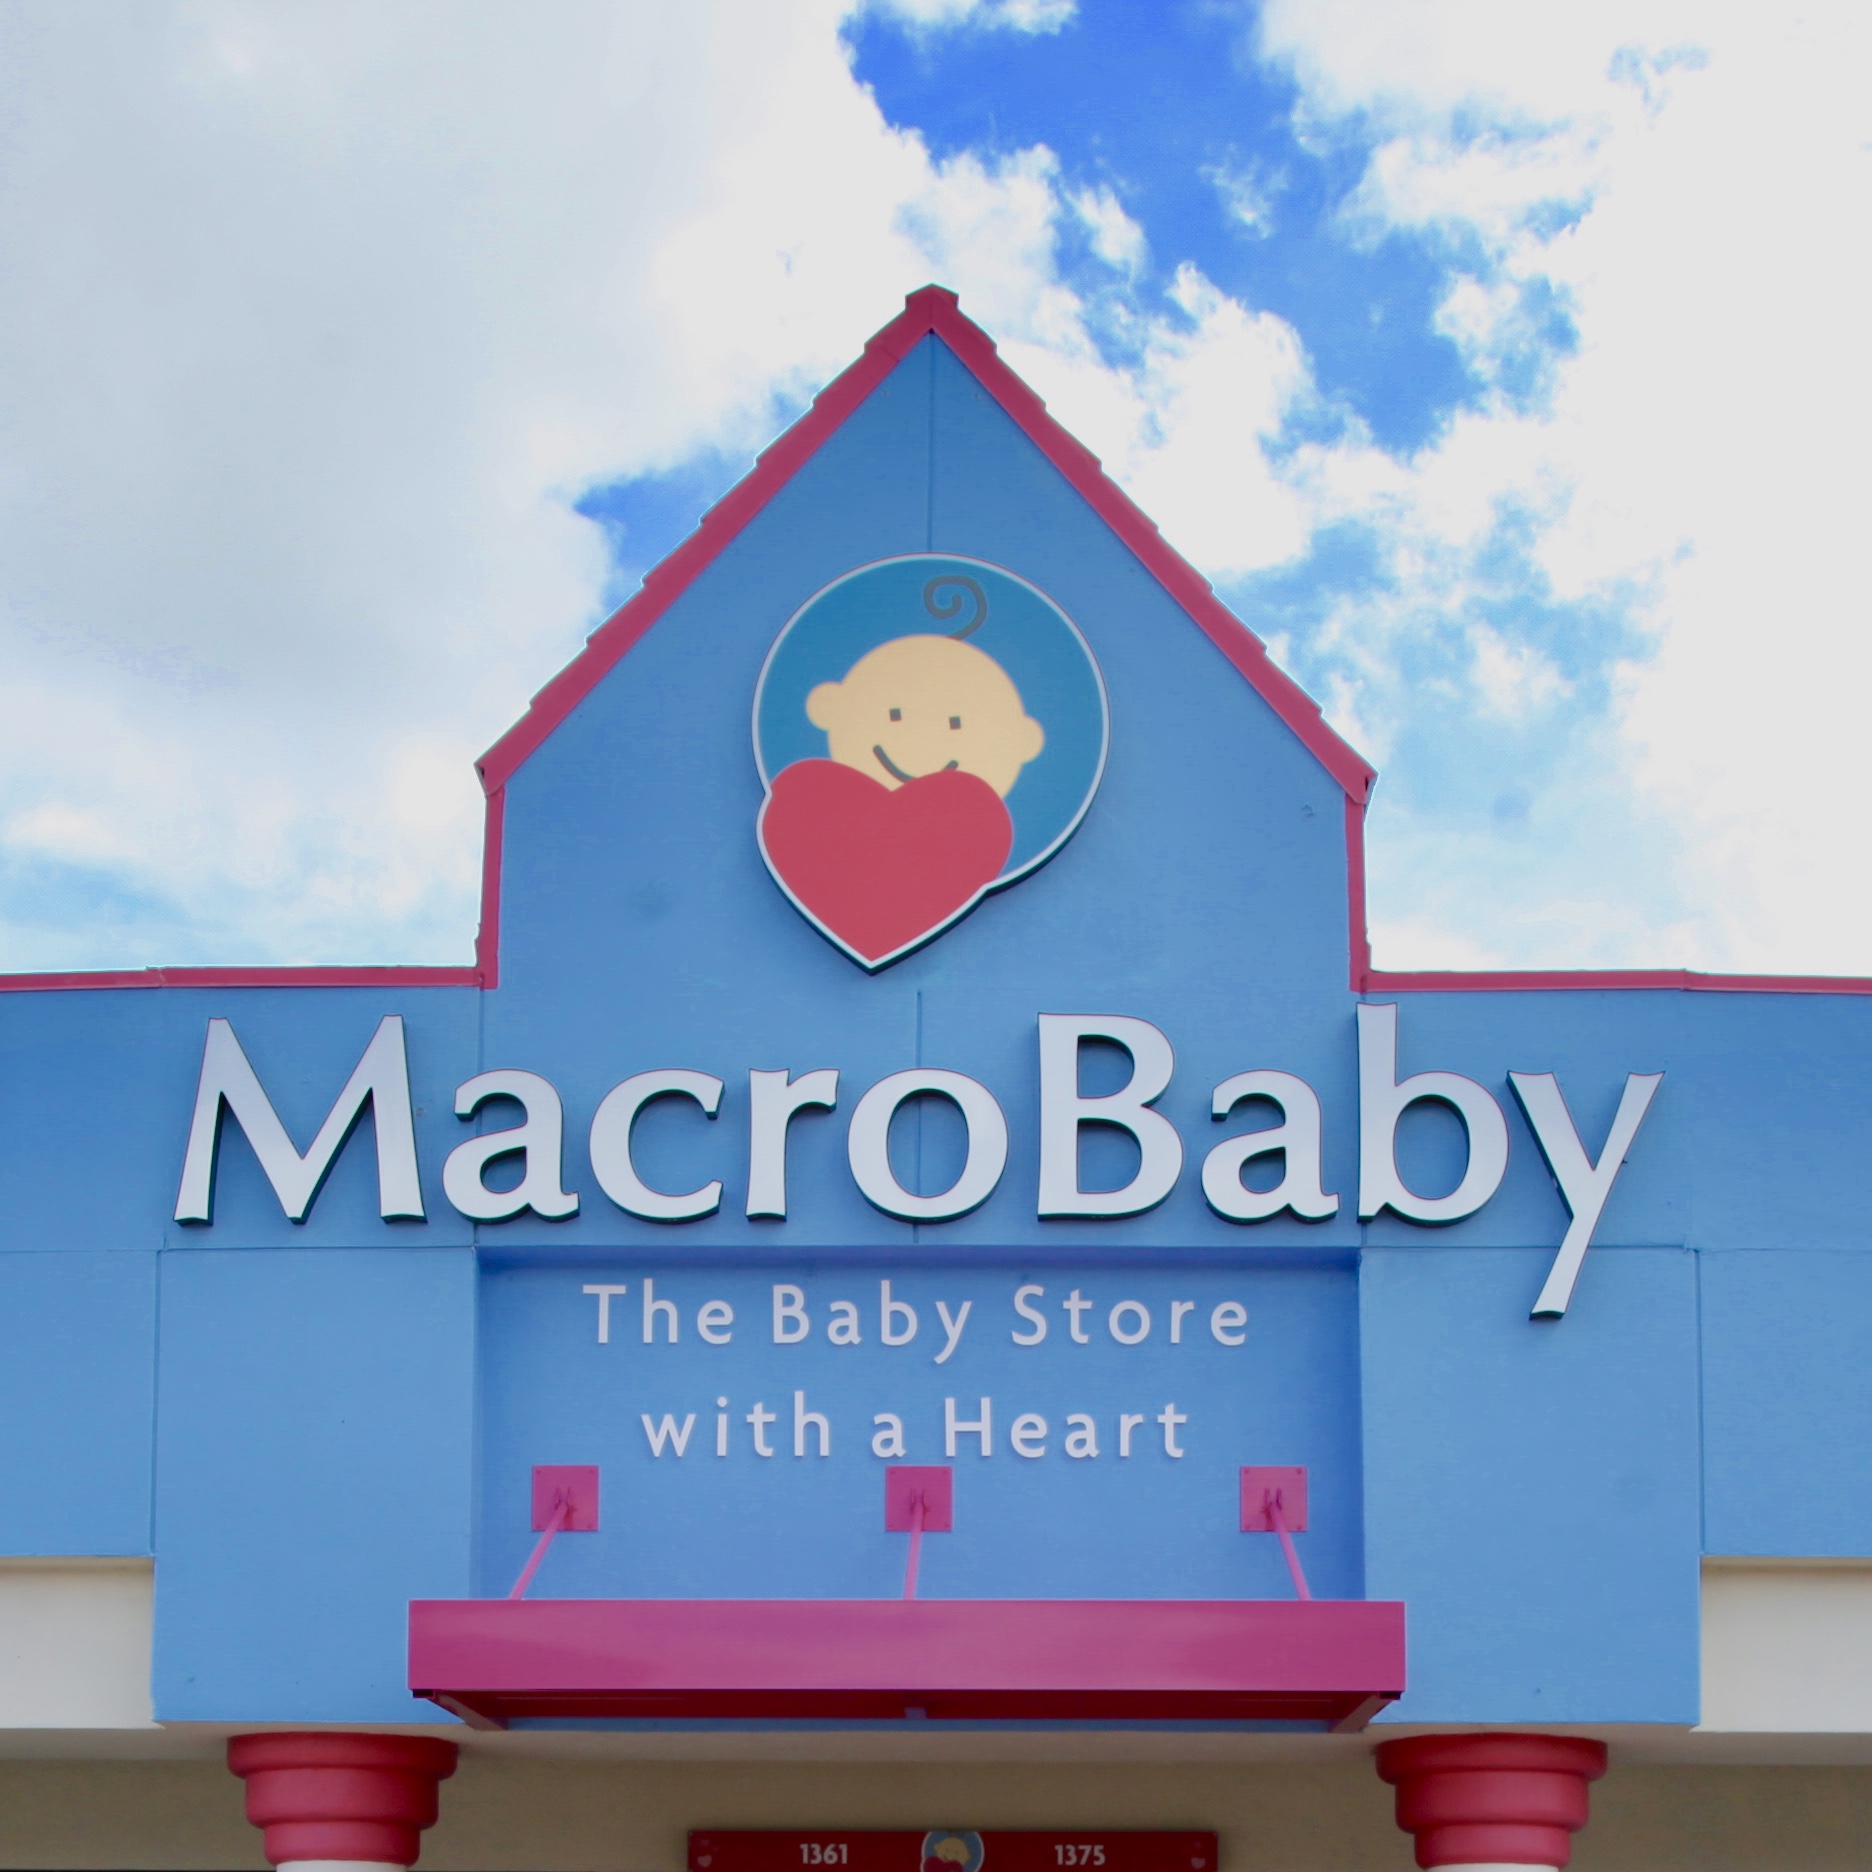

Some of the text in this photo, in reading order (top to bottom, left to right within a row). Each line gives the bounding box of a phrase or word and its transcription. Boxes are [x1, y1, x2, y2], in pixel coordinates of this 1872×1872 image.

[173, 1003, 1665, 1321] MacroBaby
[583, 1278, 1248, 1365] The Baby Store
[640, 1391, 1187, 1458] with a Heart
[800, 1843, 848, 1865] 1361
[1054, 1844, 1106, 1866] 1375
